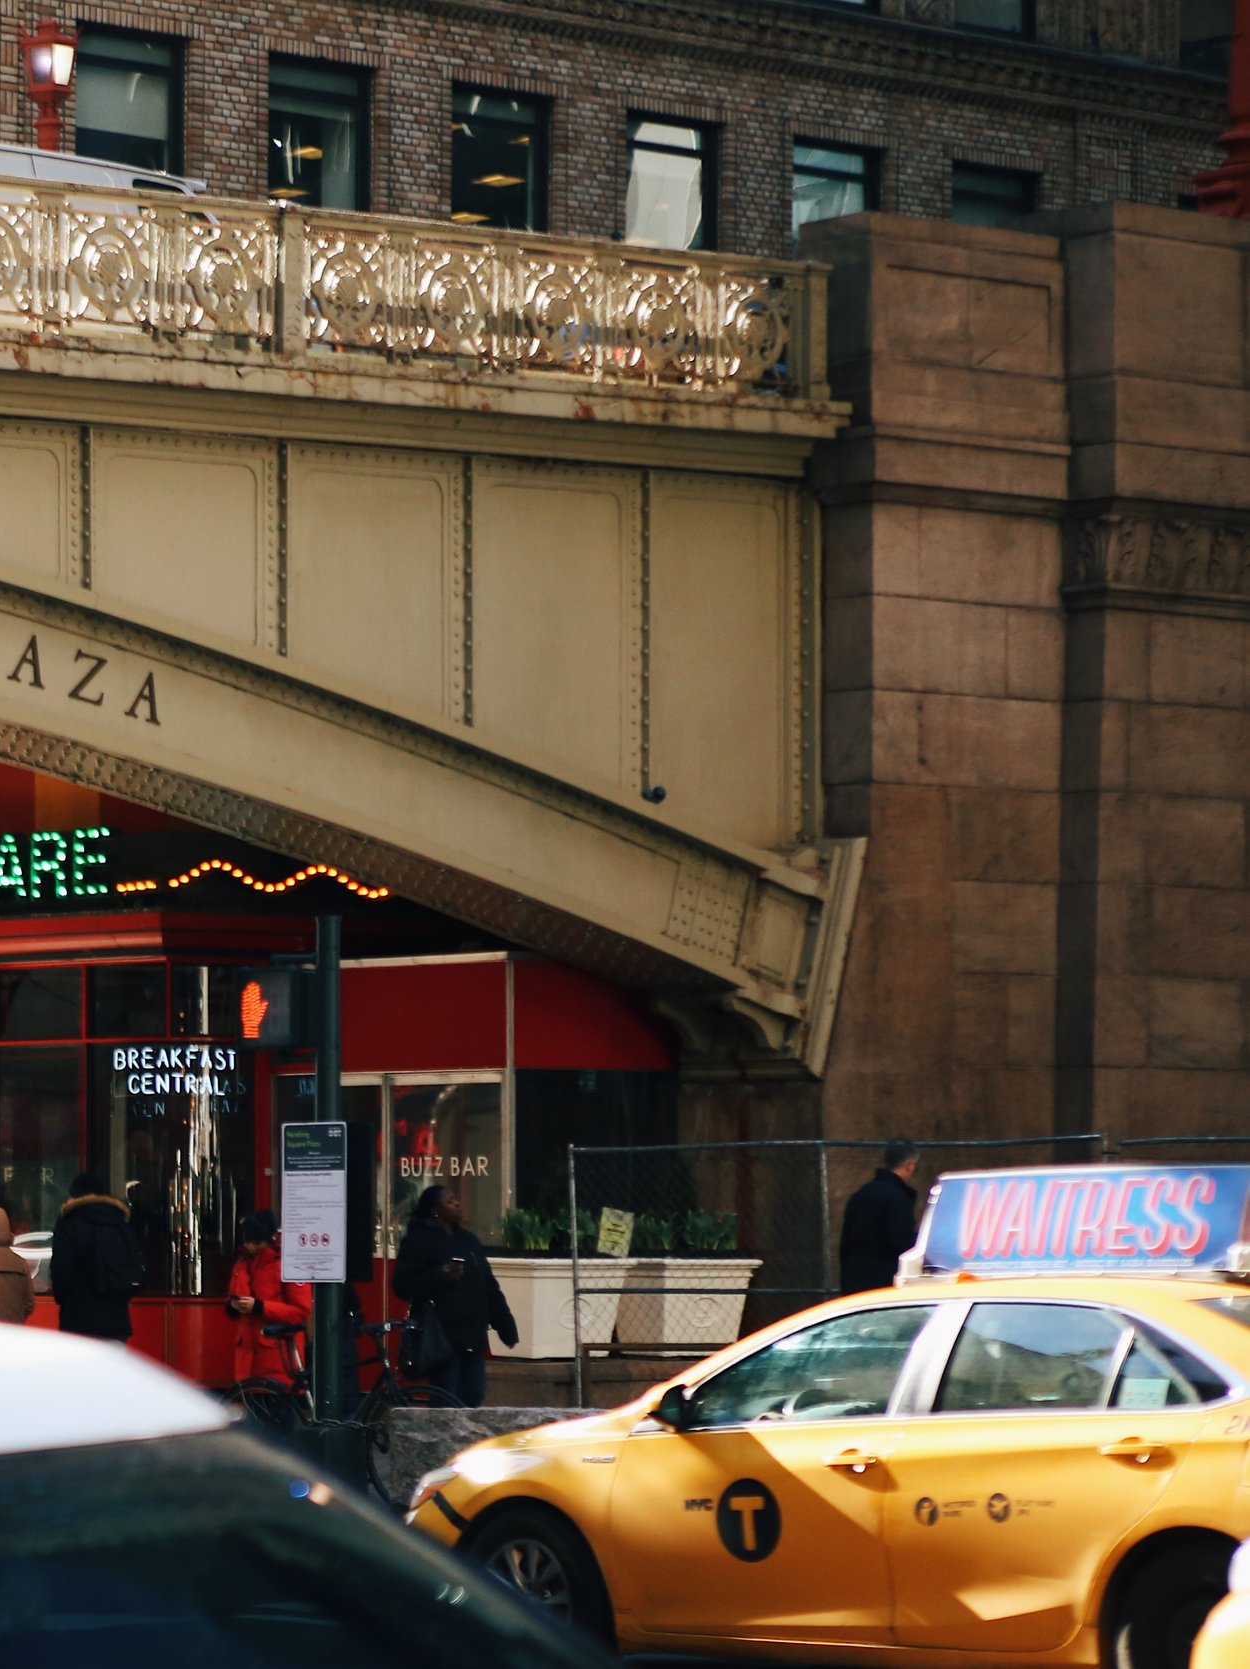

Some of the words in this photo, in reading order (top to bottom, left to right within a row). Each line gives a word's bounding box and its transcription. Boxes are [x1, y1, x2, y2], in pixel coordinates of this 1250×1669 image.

[113, 1046, 237, 1071] BREAKFAST
[127, 1072, 226, 1096] CENTRAL
[400, 1157, 444, 1177] BUZZ
[450, 1156, 490, 1177] BAR
[958, 1174, 1216, 1259] WAITRESS
